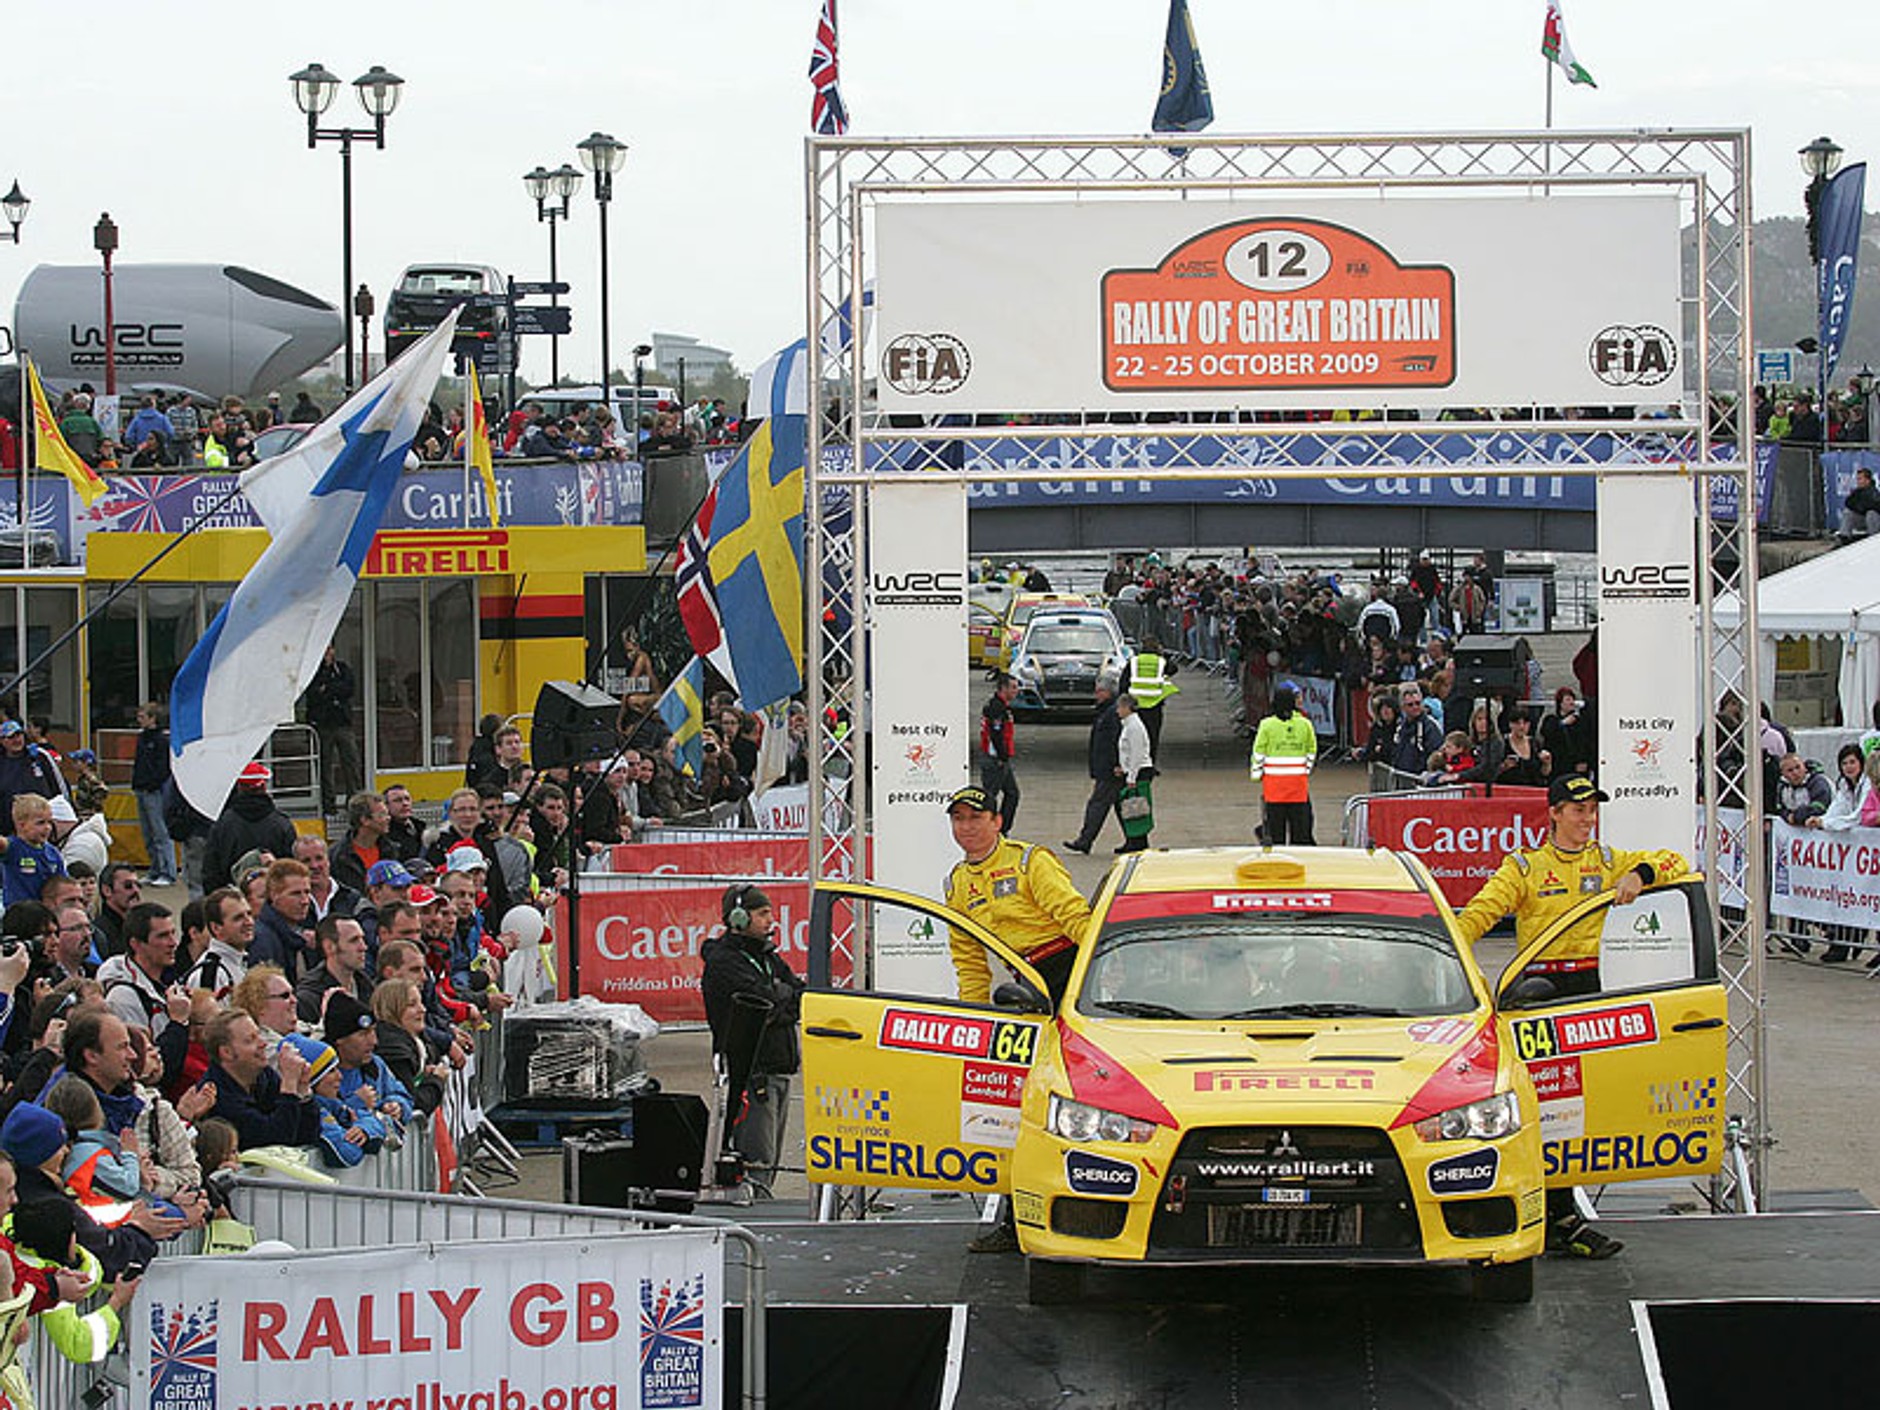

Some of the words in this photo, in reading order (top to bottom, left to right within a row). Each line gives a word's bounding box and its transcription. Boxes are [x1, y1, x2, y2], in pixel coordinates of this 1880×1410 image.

[1248, 242, 1307, 278] 12
[1113, 301, 1192, 345] RALLY
[1199, 300, 1234, 344] OF
[1237, 300, 1325, 343] GREAT
[1329, 298, 1440, 341] BRITAIN
[1115, 357, 1145, 377] 22
[1164, 357, 1194, 376] 25
[1200, 355, 1314, 376] OCTOBER
[1320, 353, 1379, 374] 2009
[1322, 433, 1578, 499] Cardiff
[202, 482, 233, 494] RALLY
[403, 478, 513, 521] Cardiff
[193, 496, 248, 514] GREAT
[366, 530, 508, 575] PIRELLI
[875, 574, 962, 591] WRC
[1602, 566, 1689, 584] WRC
[891, 723, 920, 735] host
[923, 723, 948, 738] city
[1619, 719, 1647, 731] host
[1651, 718, 1675, 732] city
[1614, 785, 1679, 799] pencadlys
[772, 806, 806, 830] RALL
[1791, 839, 1851, 872] RALLY
[1856, 846, 1880, 876] GB
[1213, 893, 1332, 908] PIRELLI
[891, 1017, 948, 1046] RALLY
[951, 1025, 981, 1050] GB
[1519, 1019, 1552, 1059] 64
[1564, 1016, 1615, 1045] RALLY
[1618, 1013, 1647, 1038] GB
[995, 1024, 1031, 1062] 64
[1194, 1069, 1376, 1092] PIRELLI
[810, 1136, 998, 1185] SHERLOG
[1543, 1130, 1708, 1176] SHERLOG
[1071, 1166, 1133, 1184] SHERLOG
[1199, 1161, 1374, 1176] www.ralliart.it
[1433, 1165, 1494, 1182] SHERLOG
[242, 1287, 482, 1362] RALLY
[509, 1281, 620, 1348] GB
[653, 1357, 700, 1372] GREAT
[645, 1372, 700, 1388] BRITAIN
[164, 1384, 211, 1400] GREAT
